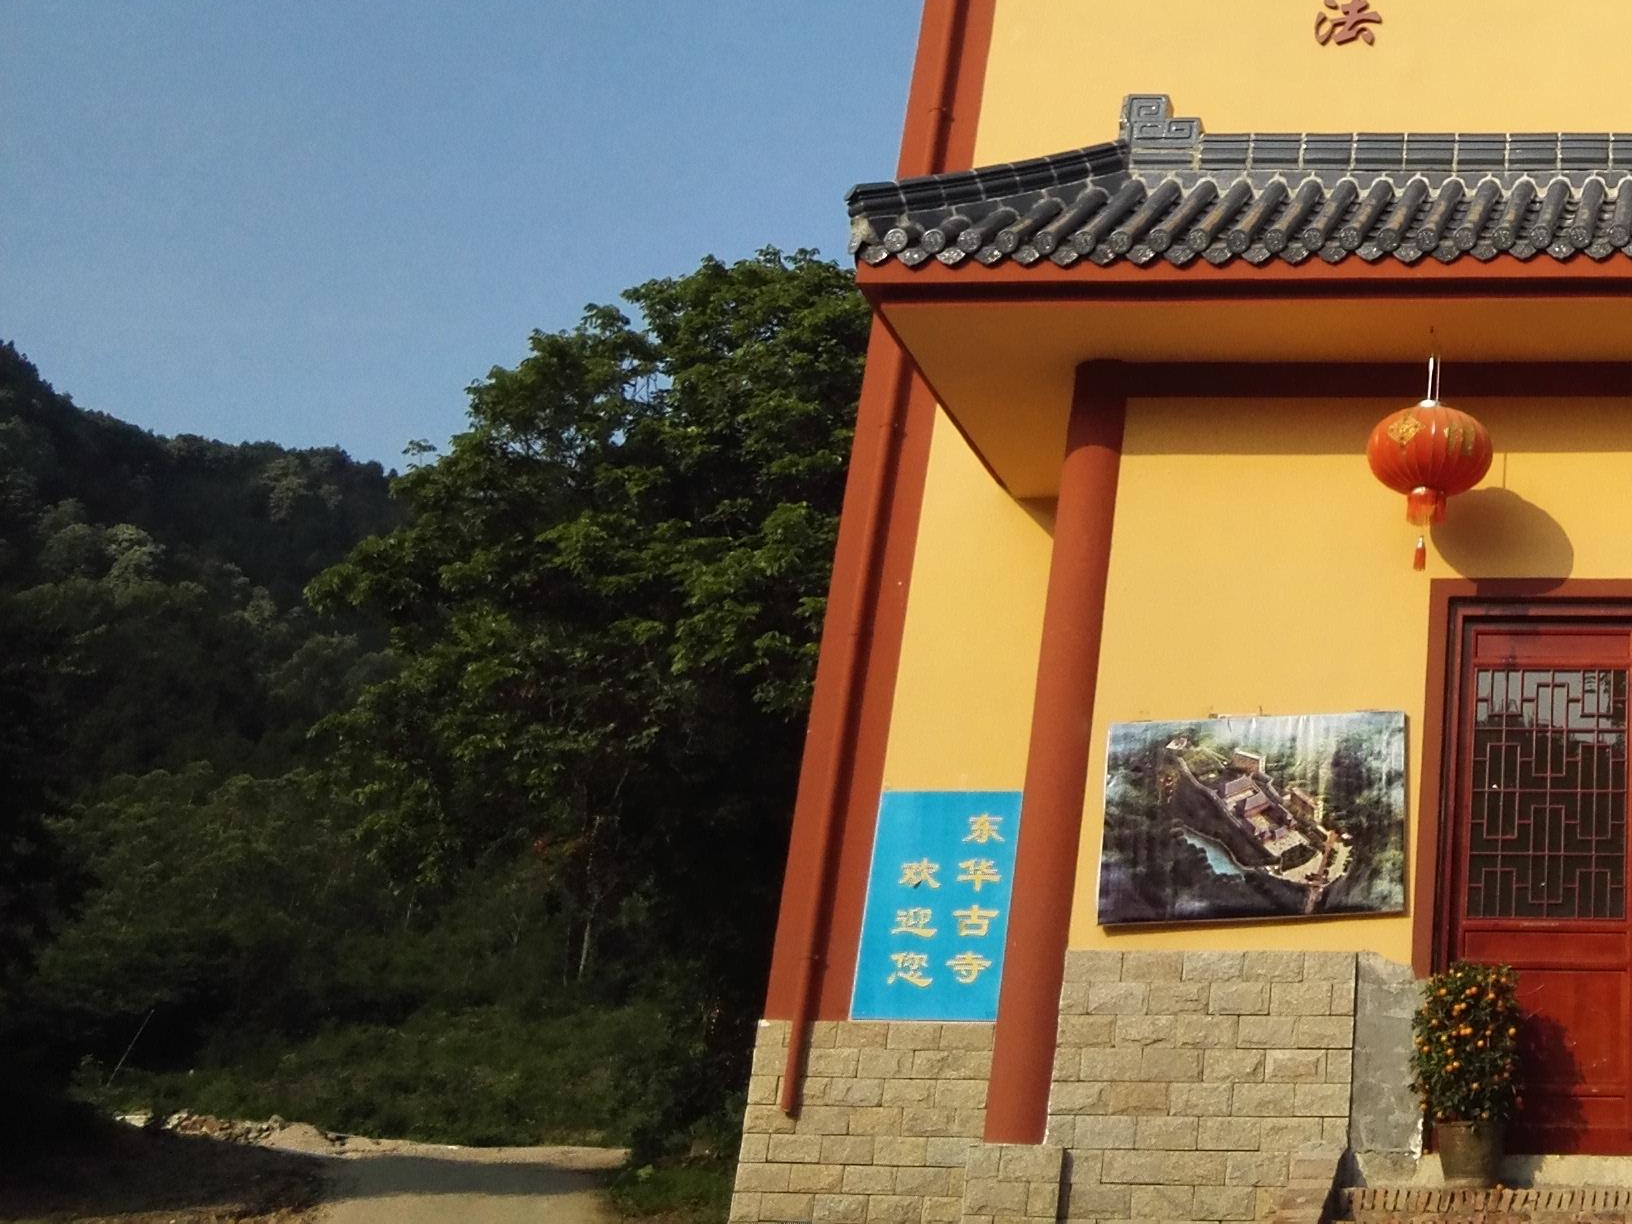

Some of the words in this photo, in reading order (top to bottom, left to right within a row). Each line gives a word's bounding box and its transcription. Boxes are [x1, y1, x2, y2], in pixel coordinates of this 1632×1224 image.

[886, 857, 942, 988] 欢迎您
[945, 812, 1005, 984] 东华古寺
